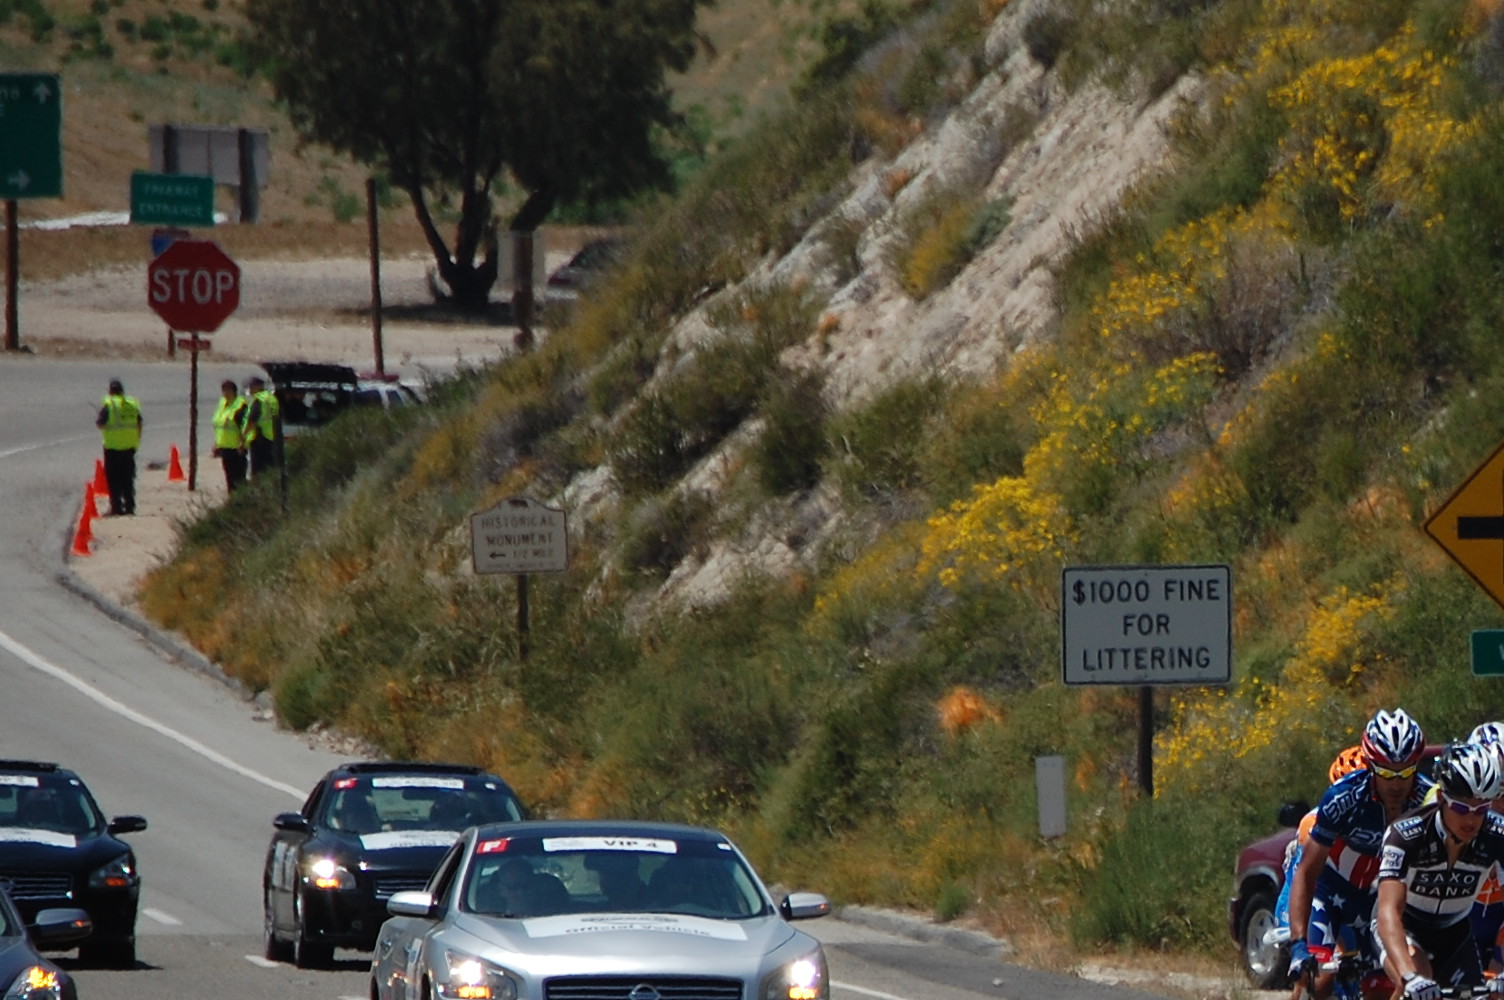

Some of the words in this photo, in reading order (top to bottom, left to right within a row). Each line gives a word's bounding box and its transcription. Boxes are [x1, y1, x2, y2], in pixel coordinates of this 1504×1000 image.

[153, 268, 234, 304] STOP
[481, 515, 556, 530] HISTORICAL
[486, 532, 552, 547] MONUMENT
[1072, 579, 1150, 606] $1000
[1164, 579, 1221, 602] FINE
[1123, 613, 1170, 637] FOR
[1083, 646, 1211, 672] LITTERING
[603, 839, 638, 848] VIP
[1419, 872, 1476, 884] SAXO
[1415, 885, 1474, 897] BANK
[565, 924, 634, 934] Official
